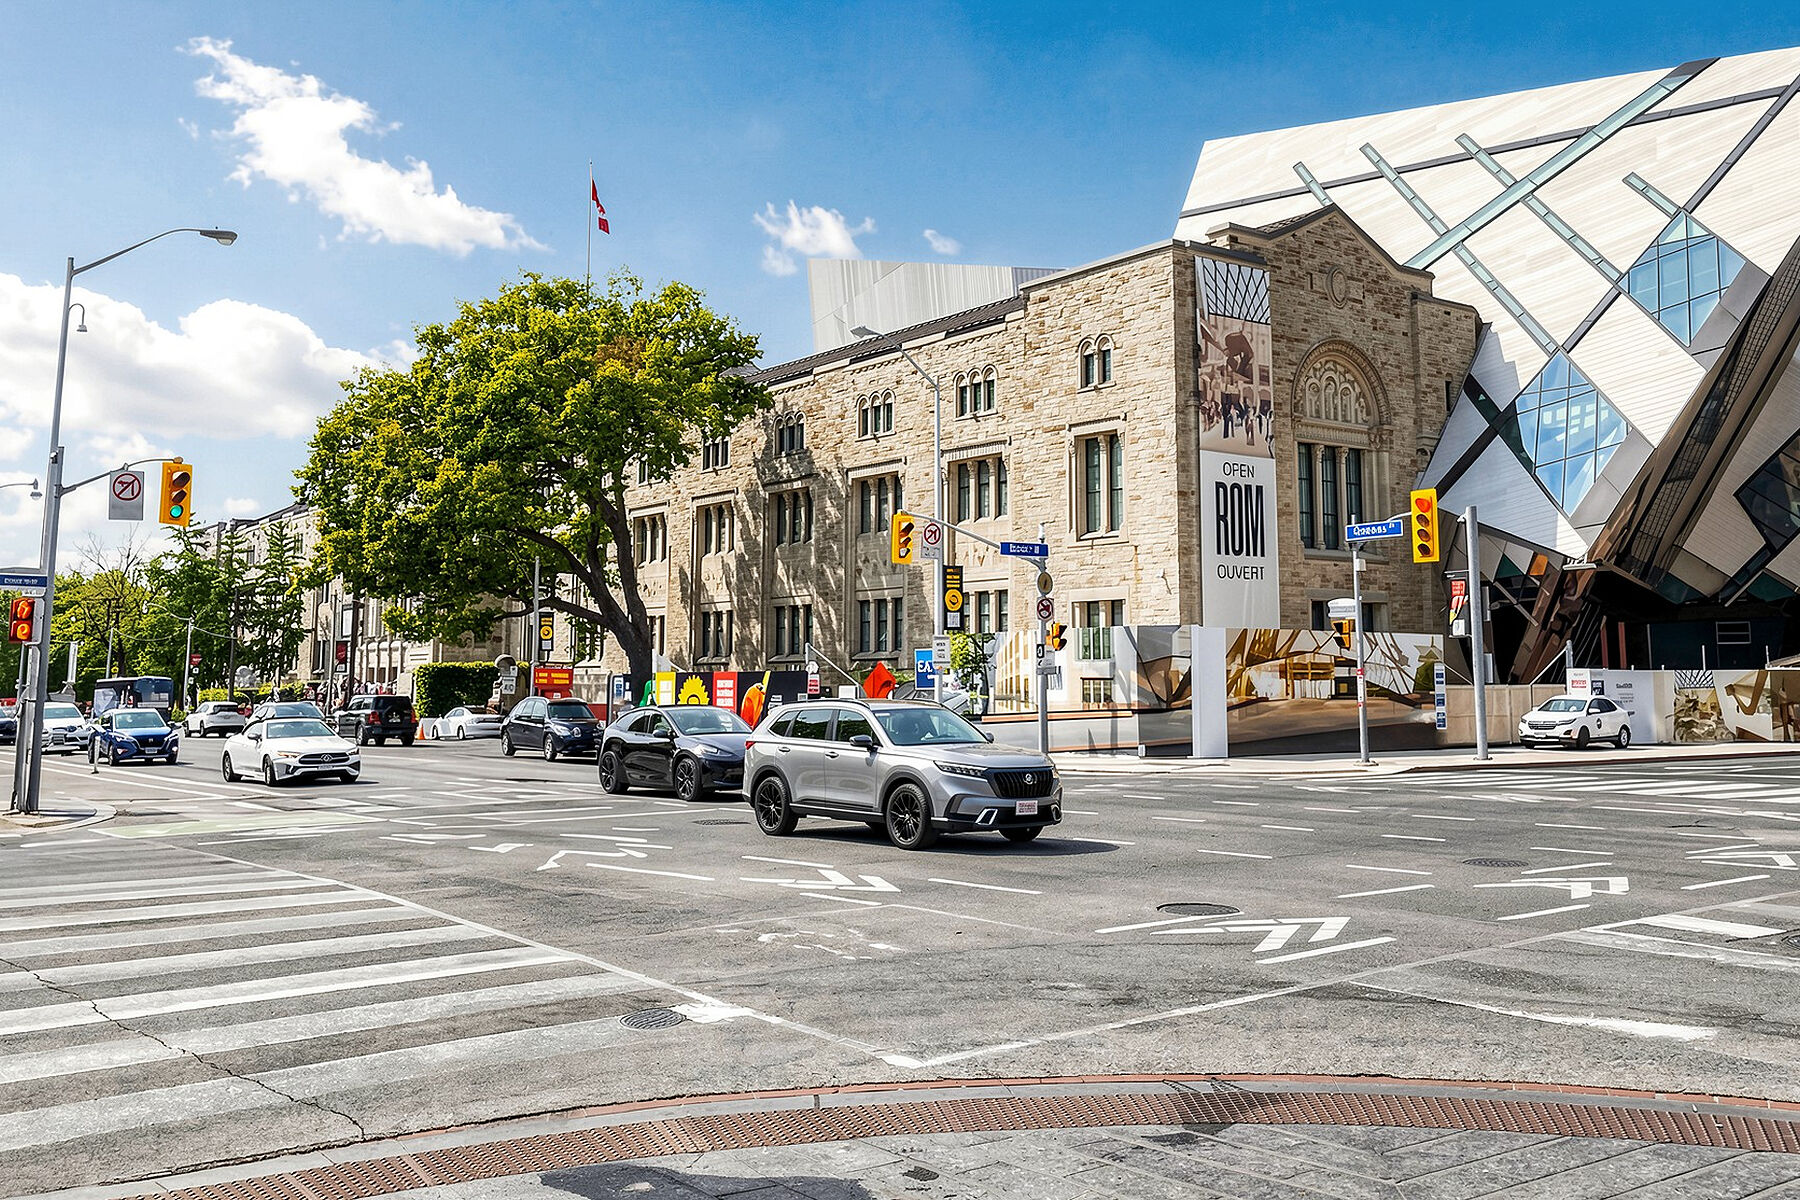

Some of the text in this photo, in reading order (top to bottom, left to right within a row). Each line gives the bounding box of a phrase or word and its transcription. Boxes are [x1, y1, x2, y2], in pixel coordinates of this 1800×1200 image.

[1222, 461, 1255, 478] OPEN
[1215, 481, 1265, 557] ROM
[1217, 564, 1265, 580] OUVERT
